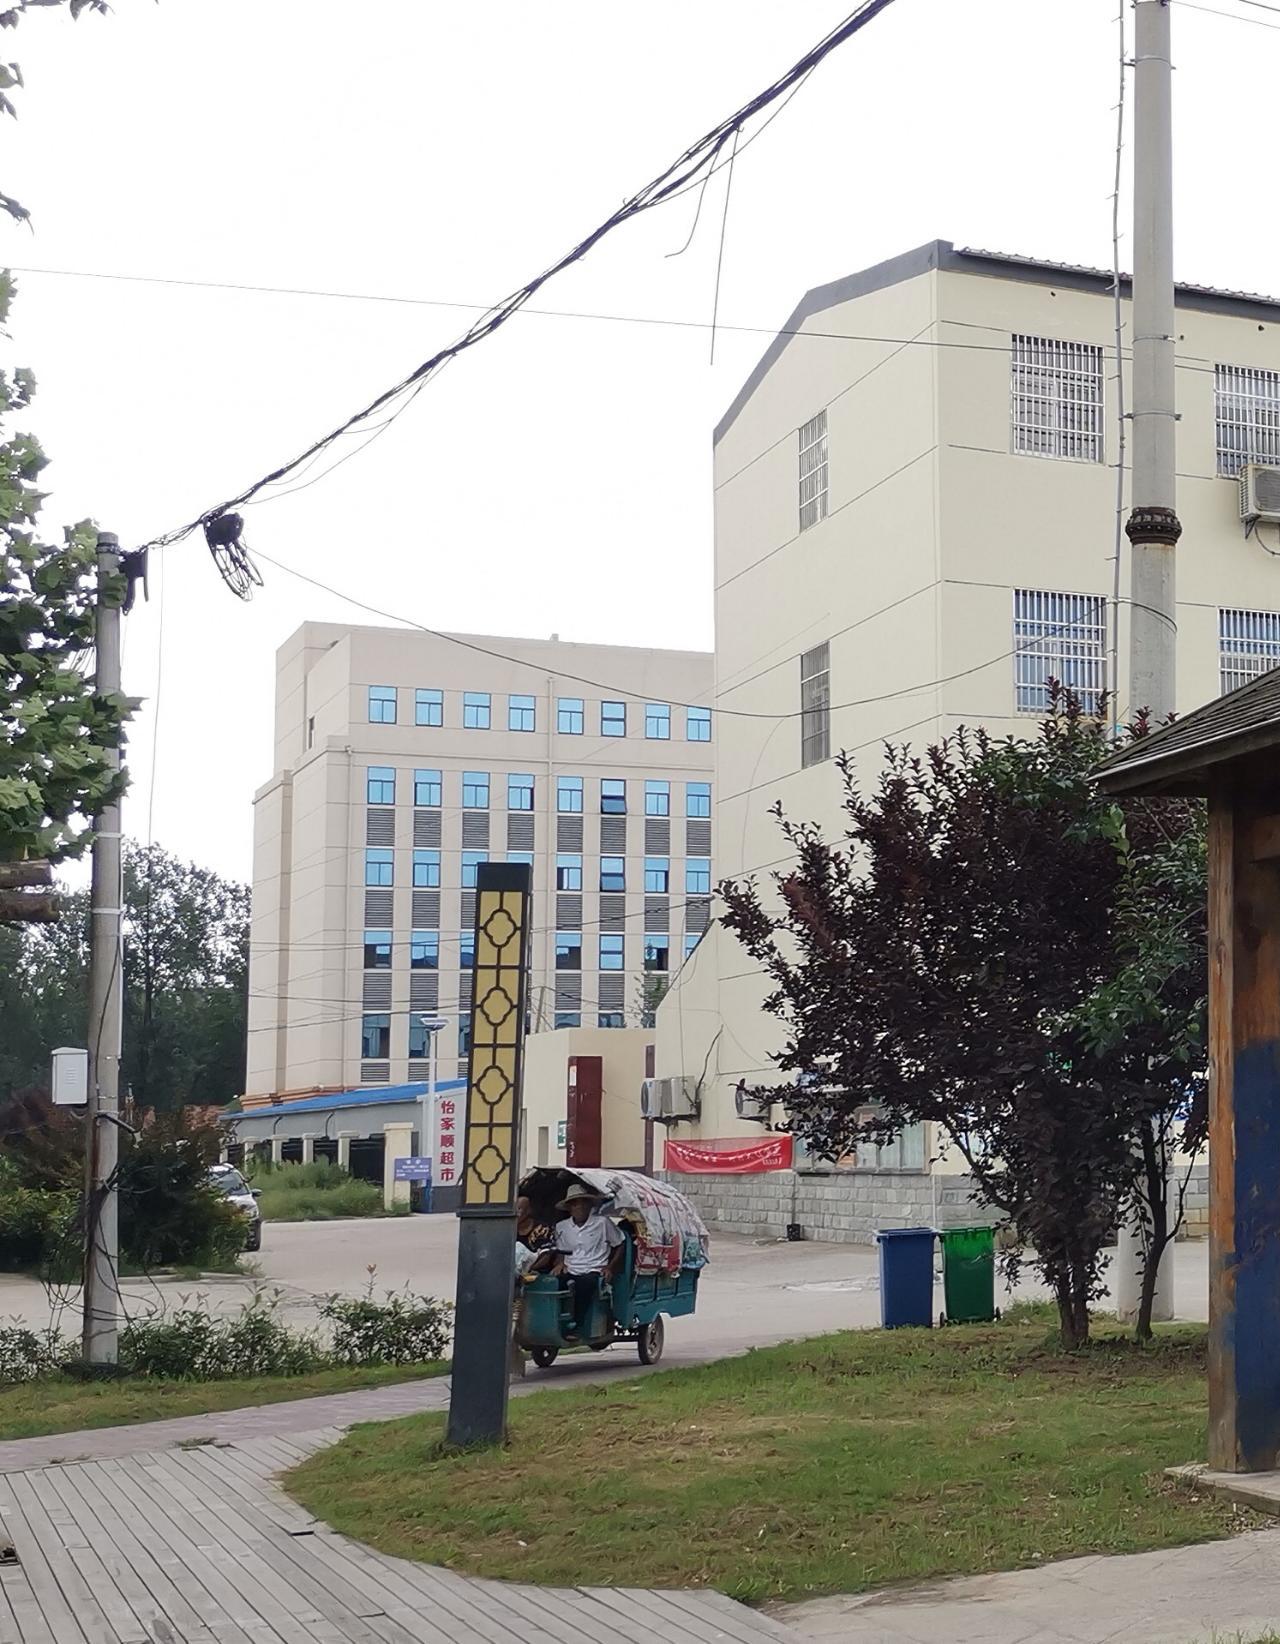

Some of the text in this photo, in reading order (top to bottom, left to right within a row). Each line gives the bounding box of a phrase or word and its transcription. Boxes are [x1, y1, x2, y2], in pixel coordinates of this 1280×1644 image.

[440, 1100, 455, 1182] 怡家顺超市
